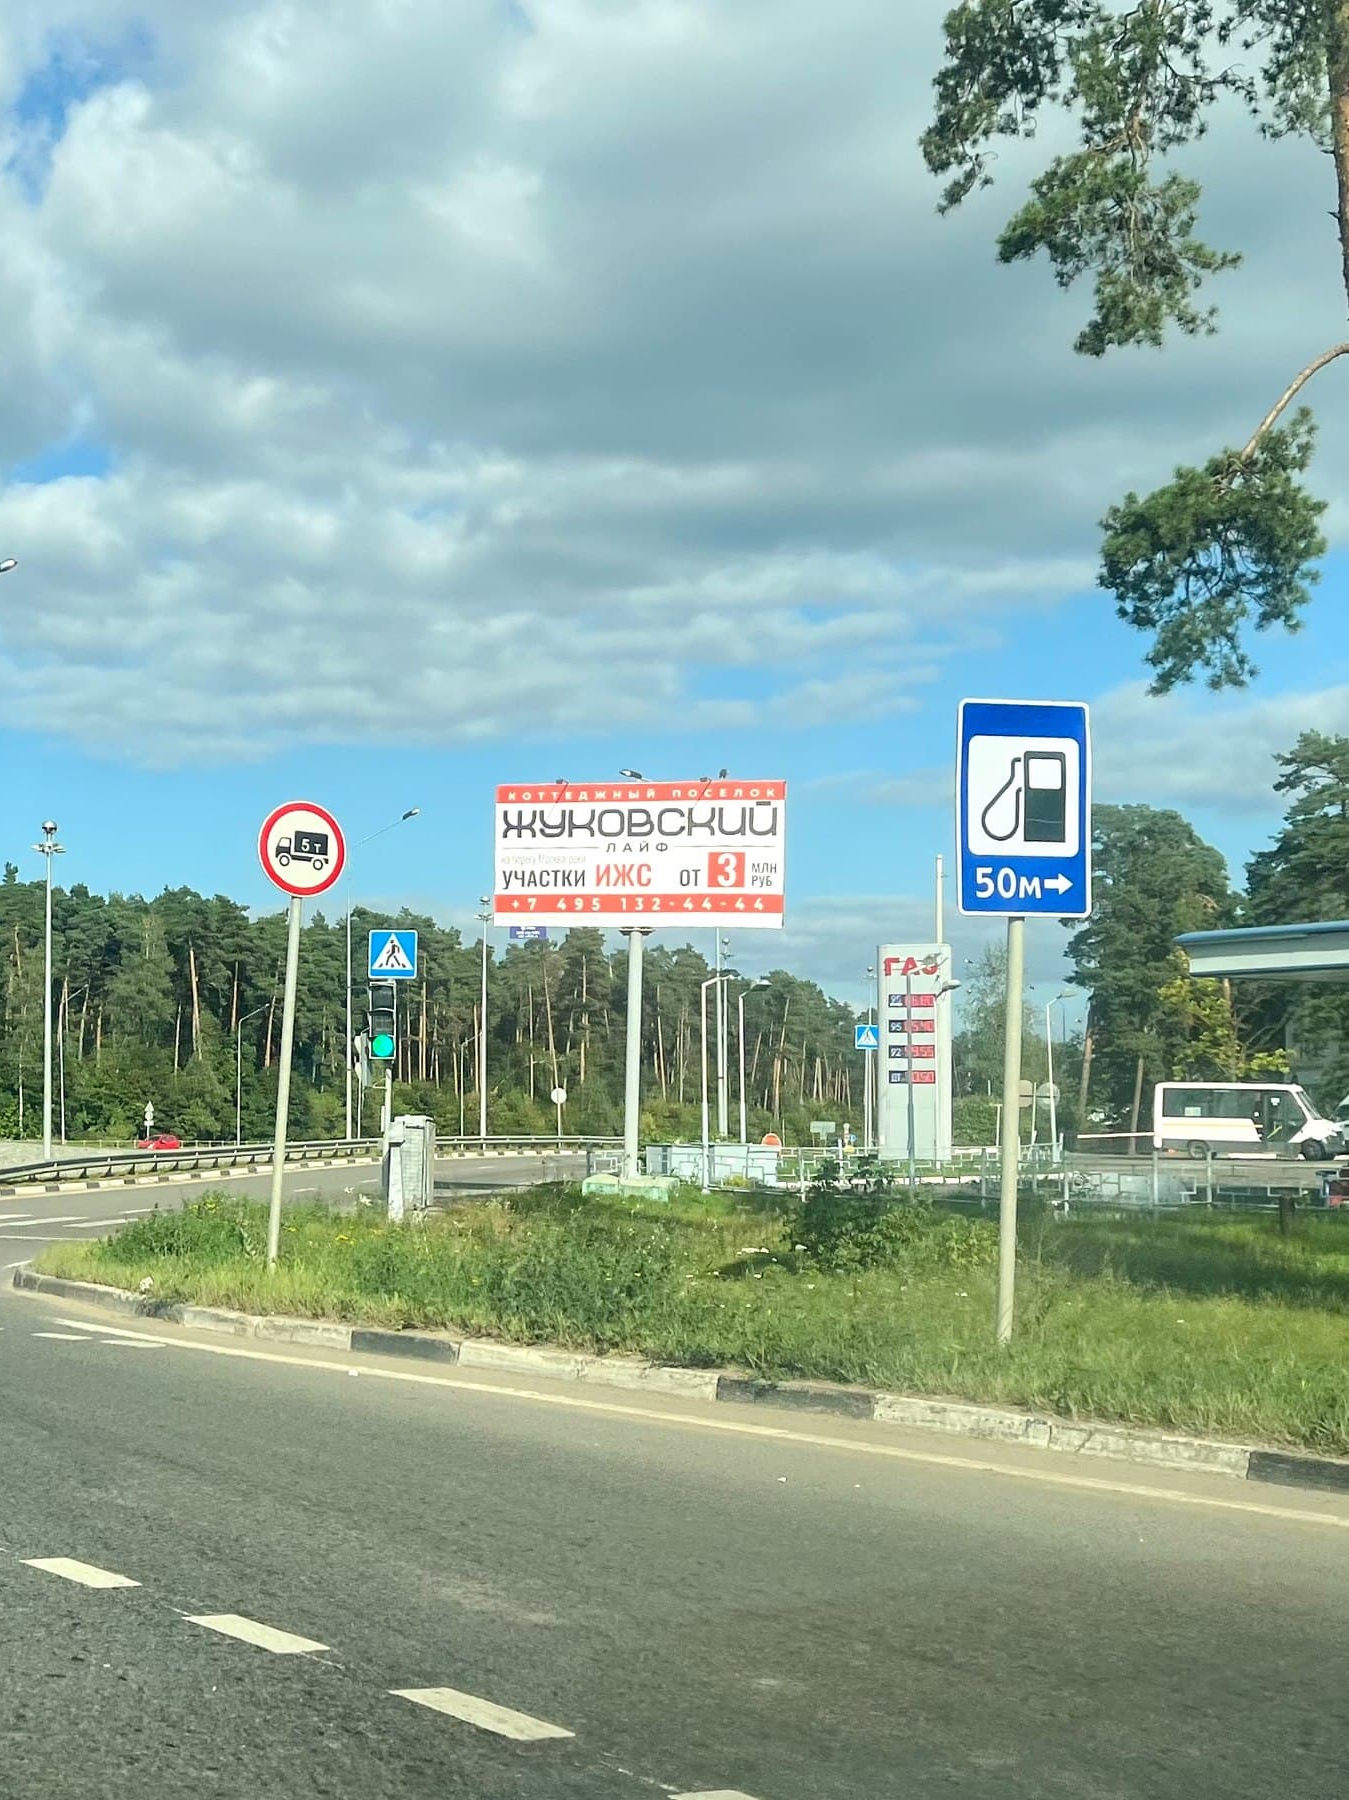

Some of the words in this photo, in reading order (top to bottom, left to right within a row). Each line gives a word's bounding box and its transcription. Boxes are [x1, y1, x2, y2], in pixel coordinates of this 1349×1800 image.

[508, 788, 656, 801] КОТТЕДЖНЫЙ
[672, 787, 776, 798] ПОСЕЛОК
[502, 801, 778, 839] ЖУКОВСКИЙ
[606, 840, 668, 853] ЛАЙФ
[502, 869, 586, 890] УЧАСТКИ
[595, 863, 652, 888] ИЖС
[679, 869, 701, 887] ОТ
[716, 853, 738, 887] 3
[751, 862, 777, 874] МЛН
[751, 875, 772, 888] РУБ
[556, 897, 601, 911] 495
[620, 897, 764, 911] 132-44-44
[890, 1048, 902, 1057] 92
